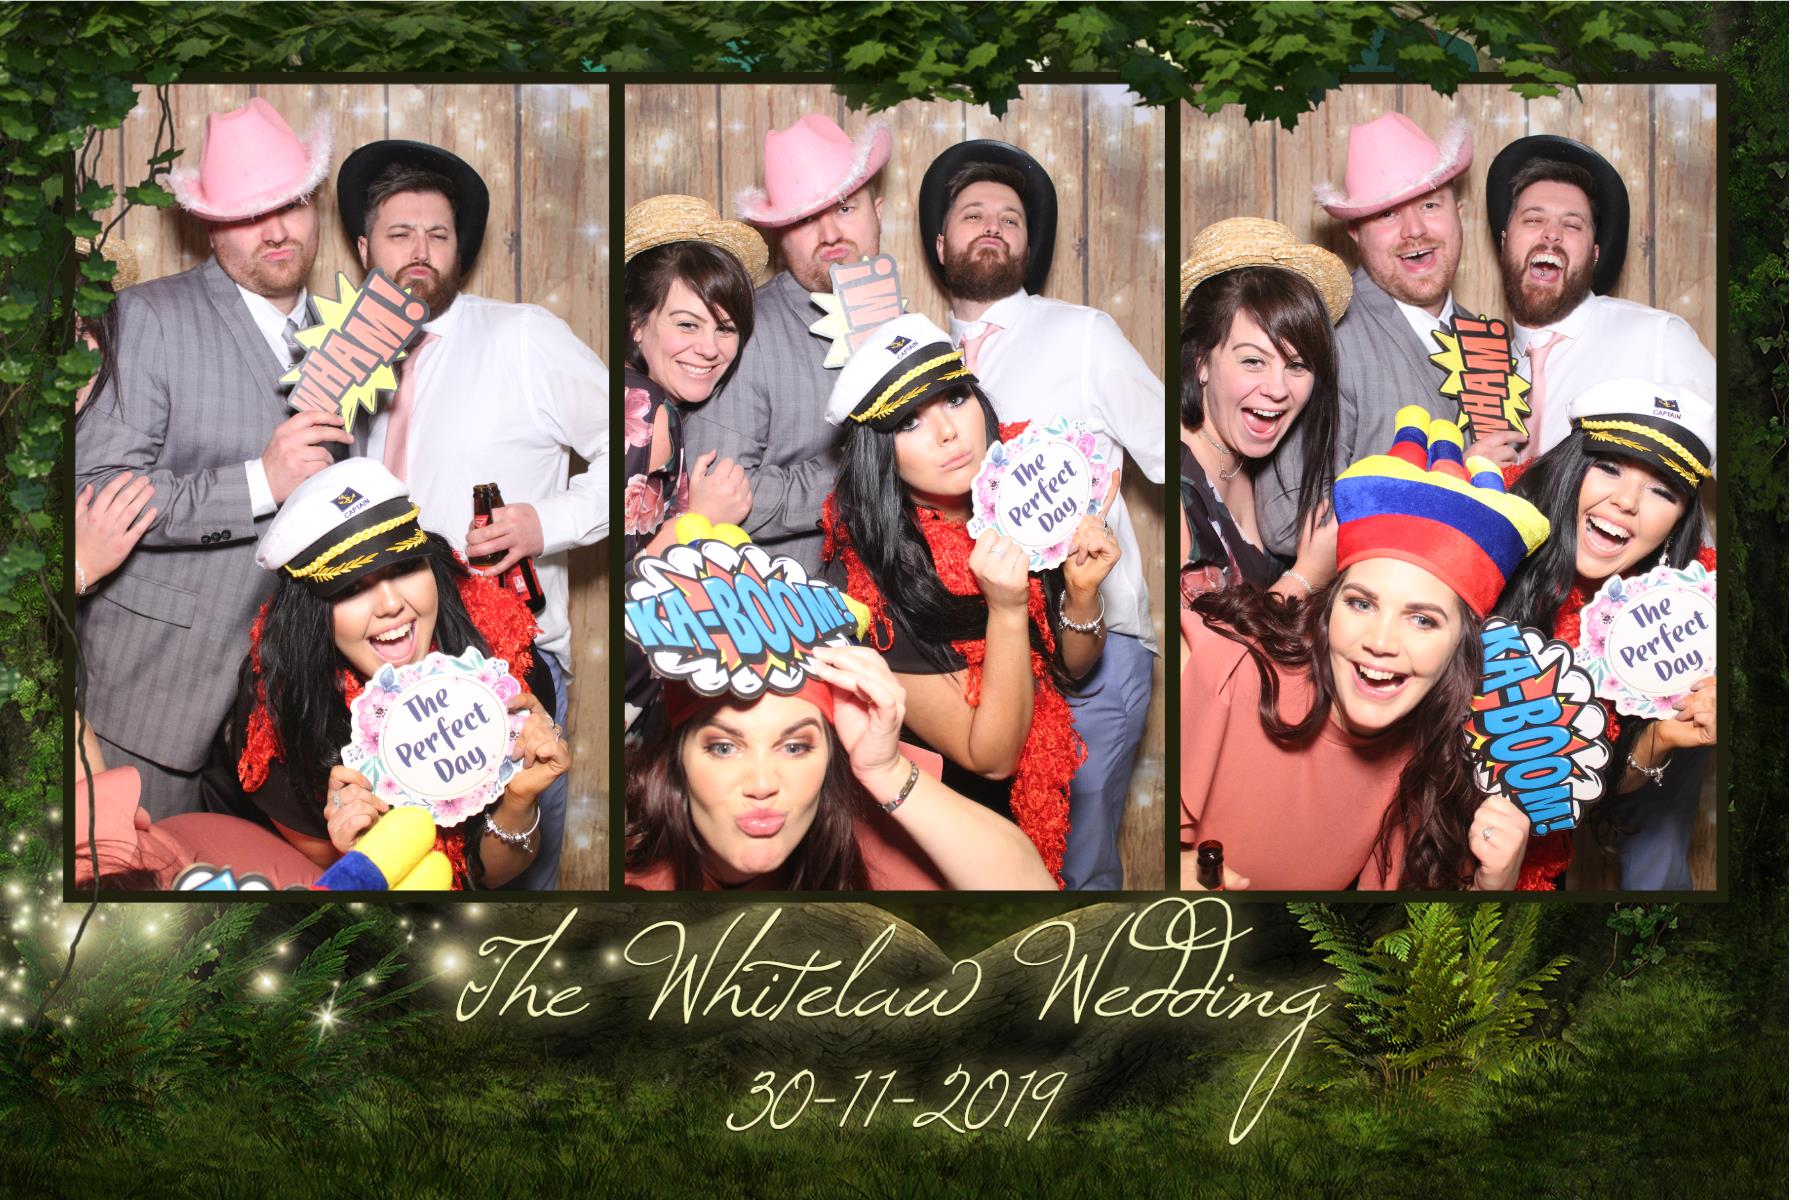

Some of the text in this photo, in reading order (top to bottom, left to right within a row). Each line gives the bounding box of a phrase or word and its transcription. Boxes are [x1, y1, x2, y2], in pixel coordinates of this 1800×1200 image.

[290, 273, 425, 414] WHAM!
[897, 340, 918, 360] CAPTAIN
[1455, 318, 1510, 441] WHAM!
[1653, 409, 1682, 420] CAPTAIN
[1011, 453, 1046, 487] The
[344, 498, 370, 519] CAPTAIN
[1008, 460, 1077, 527] Perfect
[1038, 497, 1077, 533] Day
[625, 573, 856, 655] KA-BOOM!
[1628, 598, 1672, 628] The
[1620, 611, 1709, 668] Perfect
[1654, 650, 1704, 681] Day
[403, 688, 449, 722] The
[395, 702, 490, 768] Perfect
[1480, 624, 1577, 836] KA-BOOM!
[433, 746, 487, 783] Day
